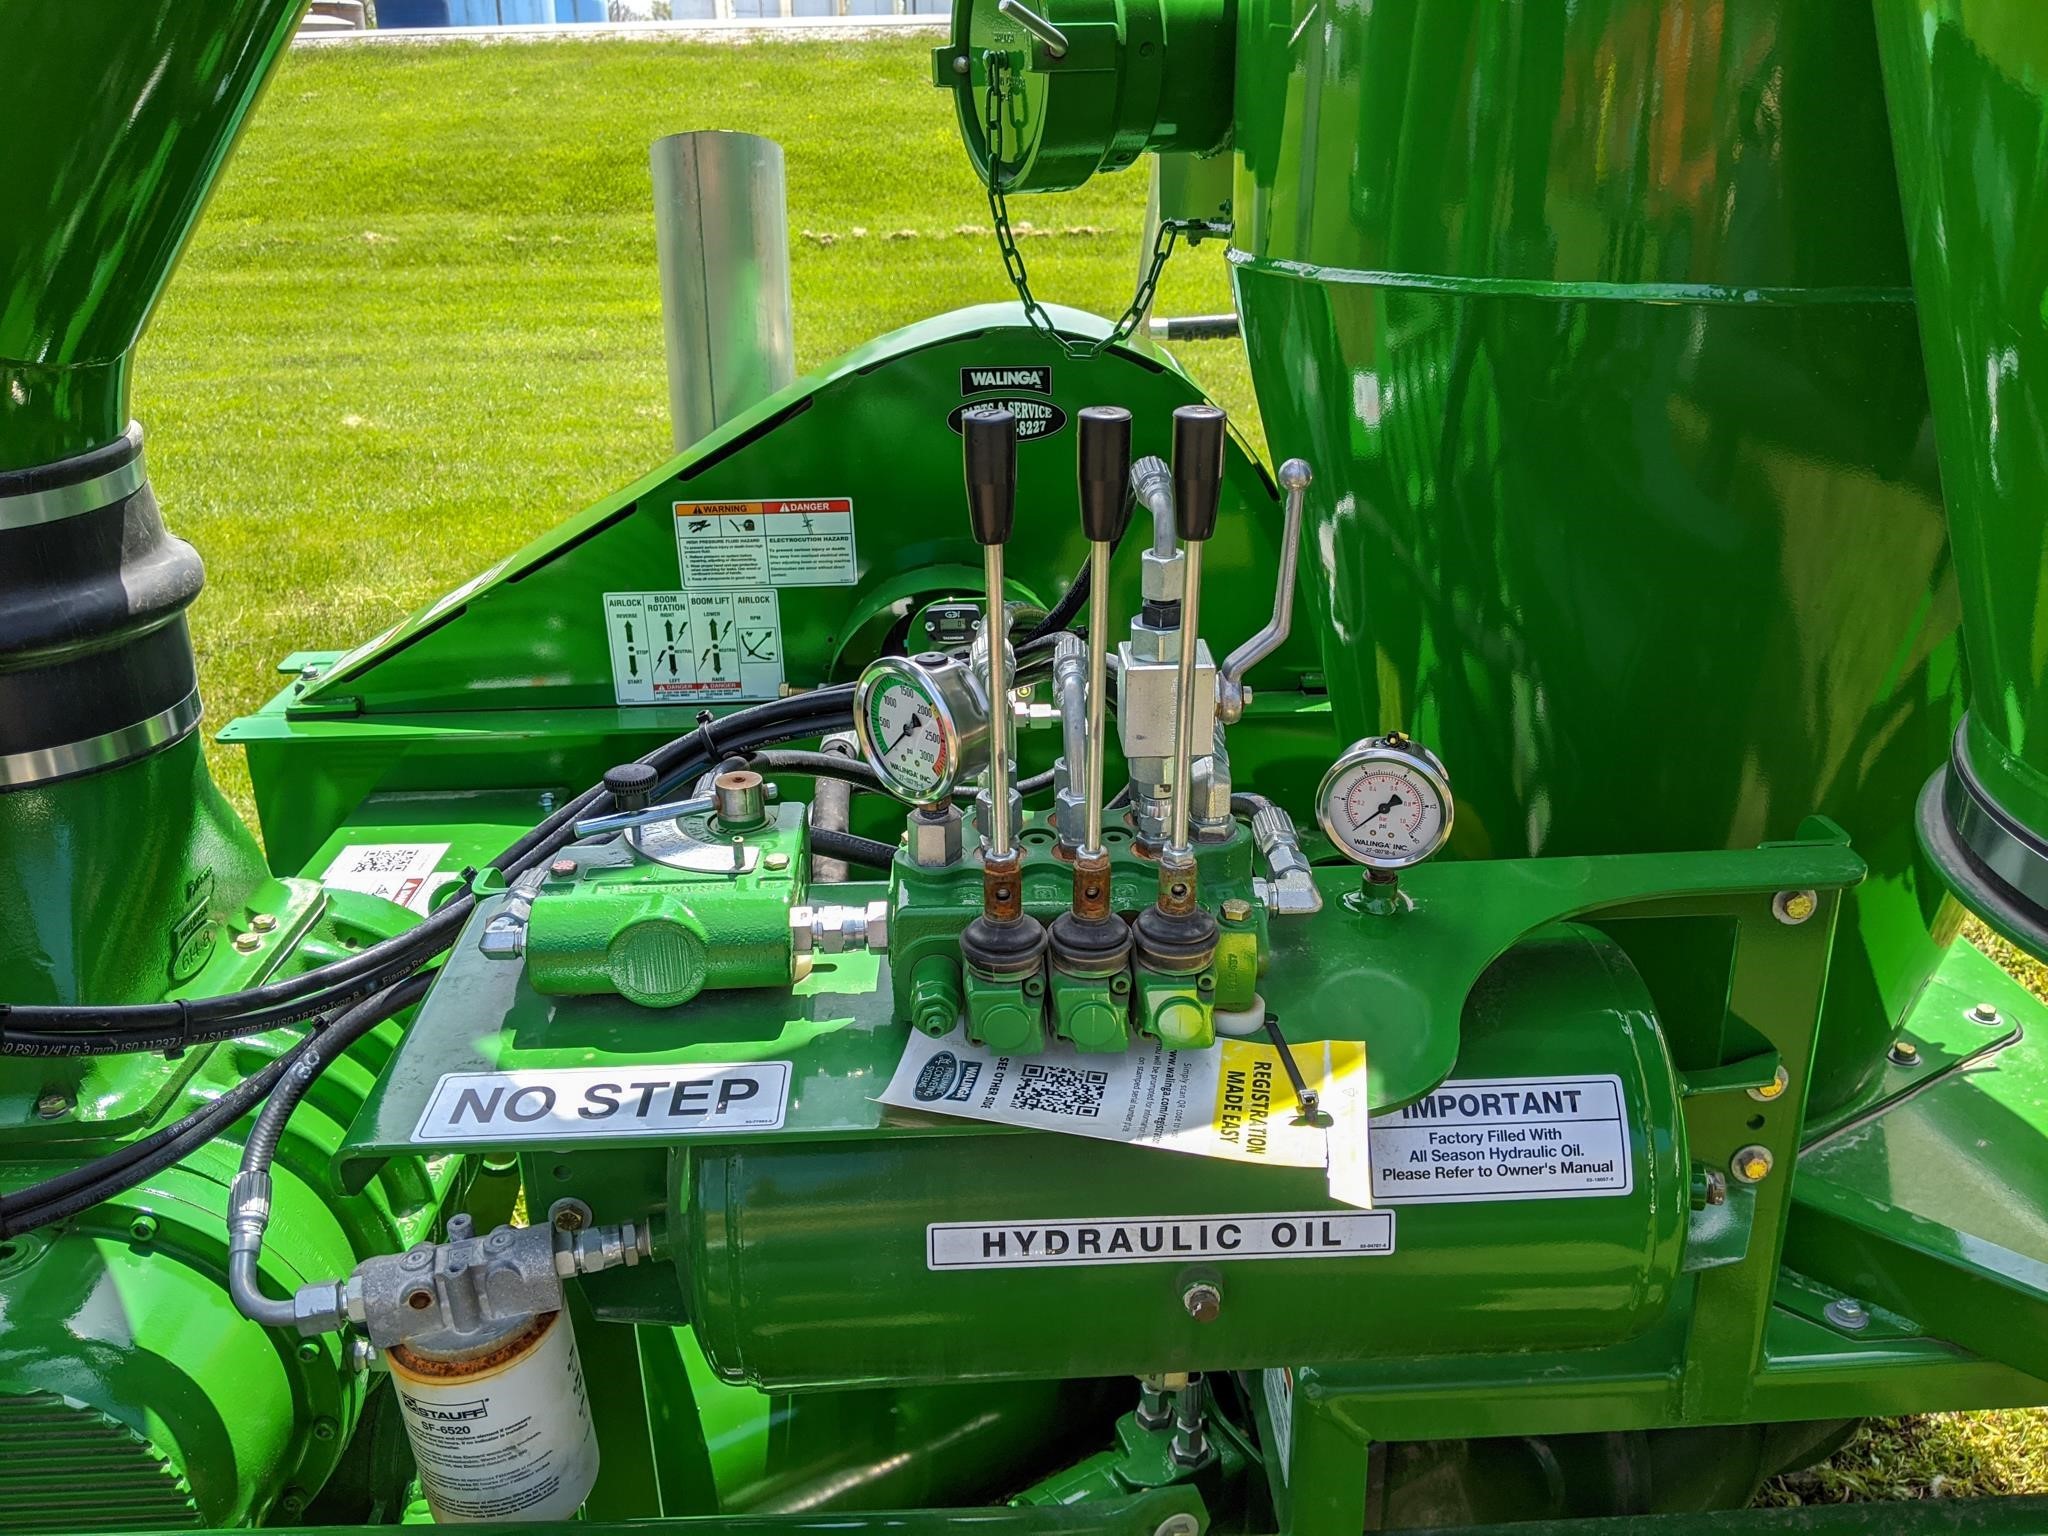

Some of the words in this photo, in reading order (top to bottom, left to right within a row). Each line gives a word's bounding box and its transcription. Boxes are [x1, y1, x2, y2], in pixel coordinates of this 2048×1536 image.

[971, 371, 1041, 386] WALINGA
[1008, 402, 1052, 418] SERVICE
[704, 504, 748, 512] WARNING
[790, 503, 830, 511] DANGER
[900, 685, 914, 699] 1500
[884, 695, 896, 708] 1000
[917, 704, 932, 718] 2000
[879, 716, 890, 729] 500
[925, 730, 940, 744] 2500
[920, 750, 934, 763] 3000
[1354, 838, 1392, 849] WALINGA
[996, 1057, 1009, 1071] SEE
[1139, 1057, 1145, 1065] on
[919, 1065, 934, 1088] SYSTEMS
[1132, 1066, 1144, 1090] stamped
[1180, 1063, 1192, 1082] Simply
[924, 1066, 944, 1096] CONVEYING
[956, 1066, 979, 1098] WALINGA
[987, 1073, 1004, 1096] OTHER
[1147, 1074, 1158, 1101] prompted
[1130, 1090, 1139, 1104] serial
[1224, 1070, 1246, 1111] MADE
[448, 1086, 557, 1124] NO
[578, 1078, 760, 1120] STEP
[980, 1096, 995, 1109] SIDE
[1177, 1100, 1186, 1108] QR
[1246, 1061, 1272, 1154] REGISTRATION
[1402, 1091, 1581, 1119] IMPORTANT
[1126, 1104, 1136, 1122] number
[1174, 1110, 1183, 1122] code
[1219, 1112, 1242, 1145] EASY
[1429, 1131, 1483, 1146] Factory
[1488, 1129, 1526, 1142] Filled
[1529, 1128, 1562, 1141] With
[1409, 1150, 1427, 1163] All
[1431, 1148, 1485, 1162] Season
[1489, 1145, 1557, 1162] Hydraulic
[1561, 1144, 1585, 1157] Oil.
[1382, 1168, 1431, 1181] Please
[1435, 1166, 1475, 1179] Refer
[1478, 1166, 1493, 1178] to
[1496, 1163, 1557, 1176] Owner's
[1561, 1161, 1614, 1174] Manual
[983, 1223, 1242, 1258] HYDRAULIC
[1271, 1220, 1342, 1248] OIL
[418, 1408, 484, 1420] STAUFF
[422, 1421, 470, 1434] SF-6520
